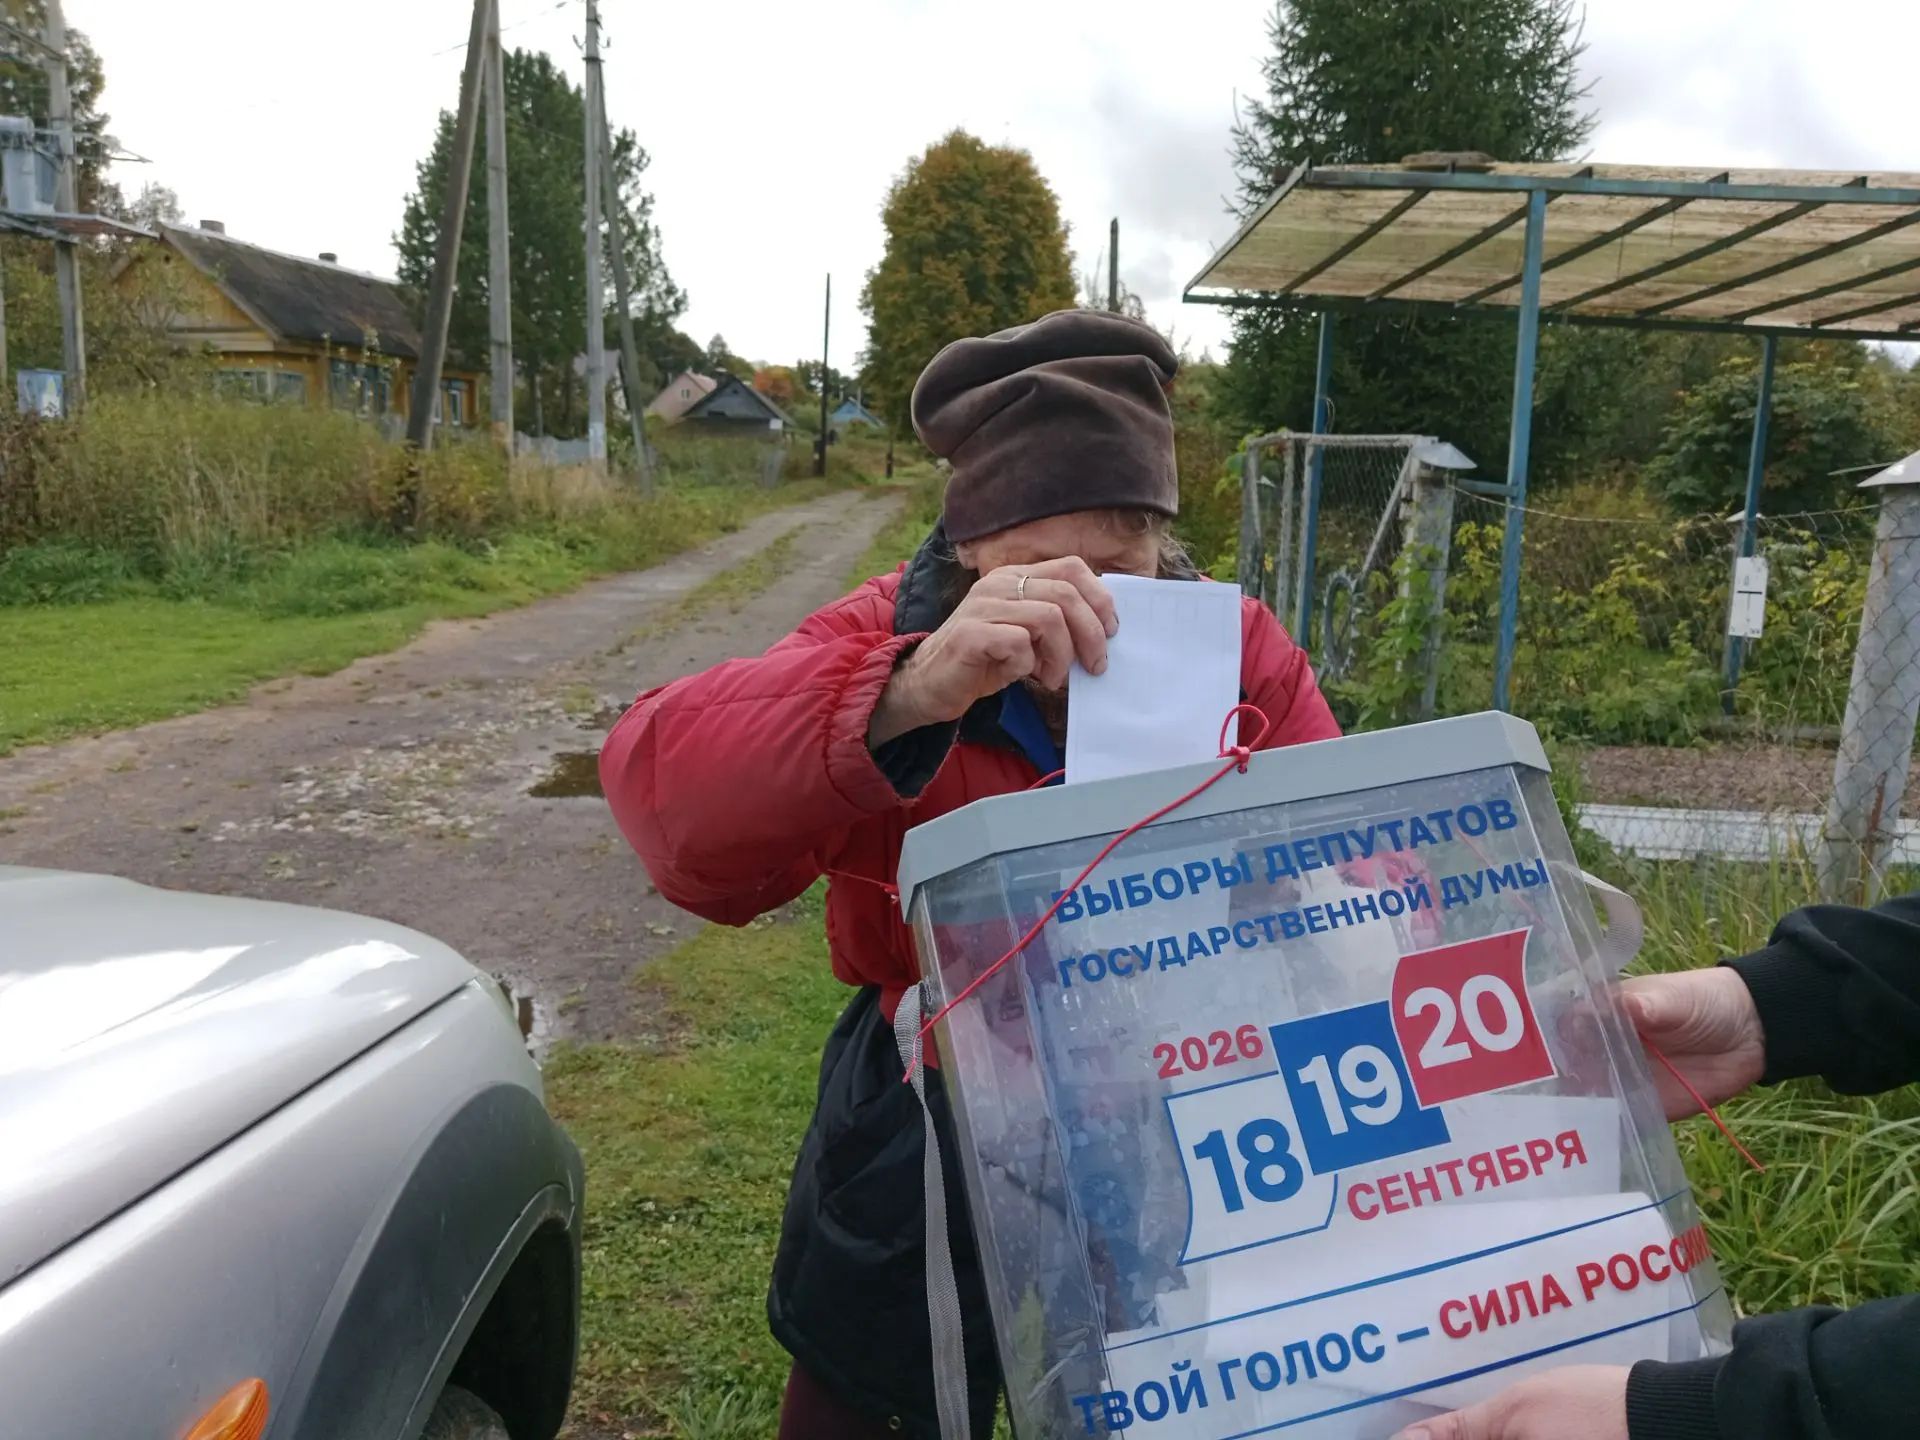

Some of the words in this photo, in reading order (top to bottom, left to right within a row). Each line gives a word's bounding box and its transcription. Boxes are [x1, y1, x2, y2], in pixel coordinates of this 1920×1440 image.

[1051, 852, 1253, 923] ВЫБОРЫ
[1263, 800, 1518, 885] ДЕПУТАТОВ
[1058, 876, 1432, 989] ГОСУДАРСТВЕННОЙ
[1439, 858, 1549, 910] ДУМЫ
[1153, 1024, 1264, 1080] 2026
[1193, 1118, 1304, 1213] 18
[1297, 1045, 1403, 1136] 19
[1404, 974, 1525, 1069] 20
[1347, 1129, 1588, 1221] СЕНТЯБРЯ
[1073, 1359, 1208, 1436] ТВОЙ
[1217, 1323, 1386, 1402] ГОЛОС
[1439, 1273, 1573, 1339] СИЛА
